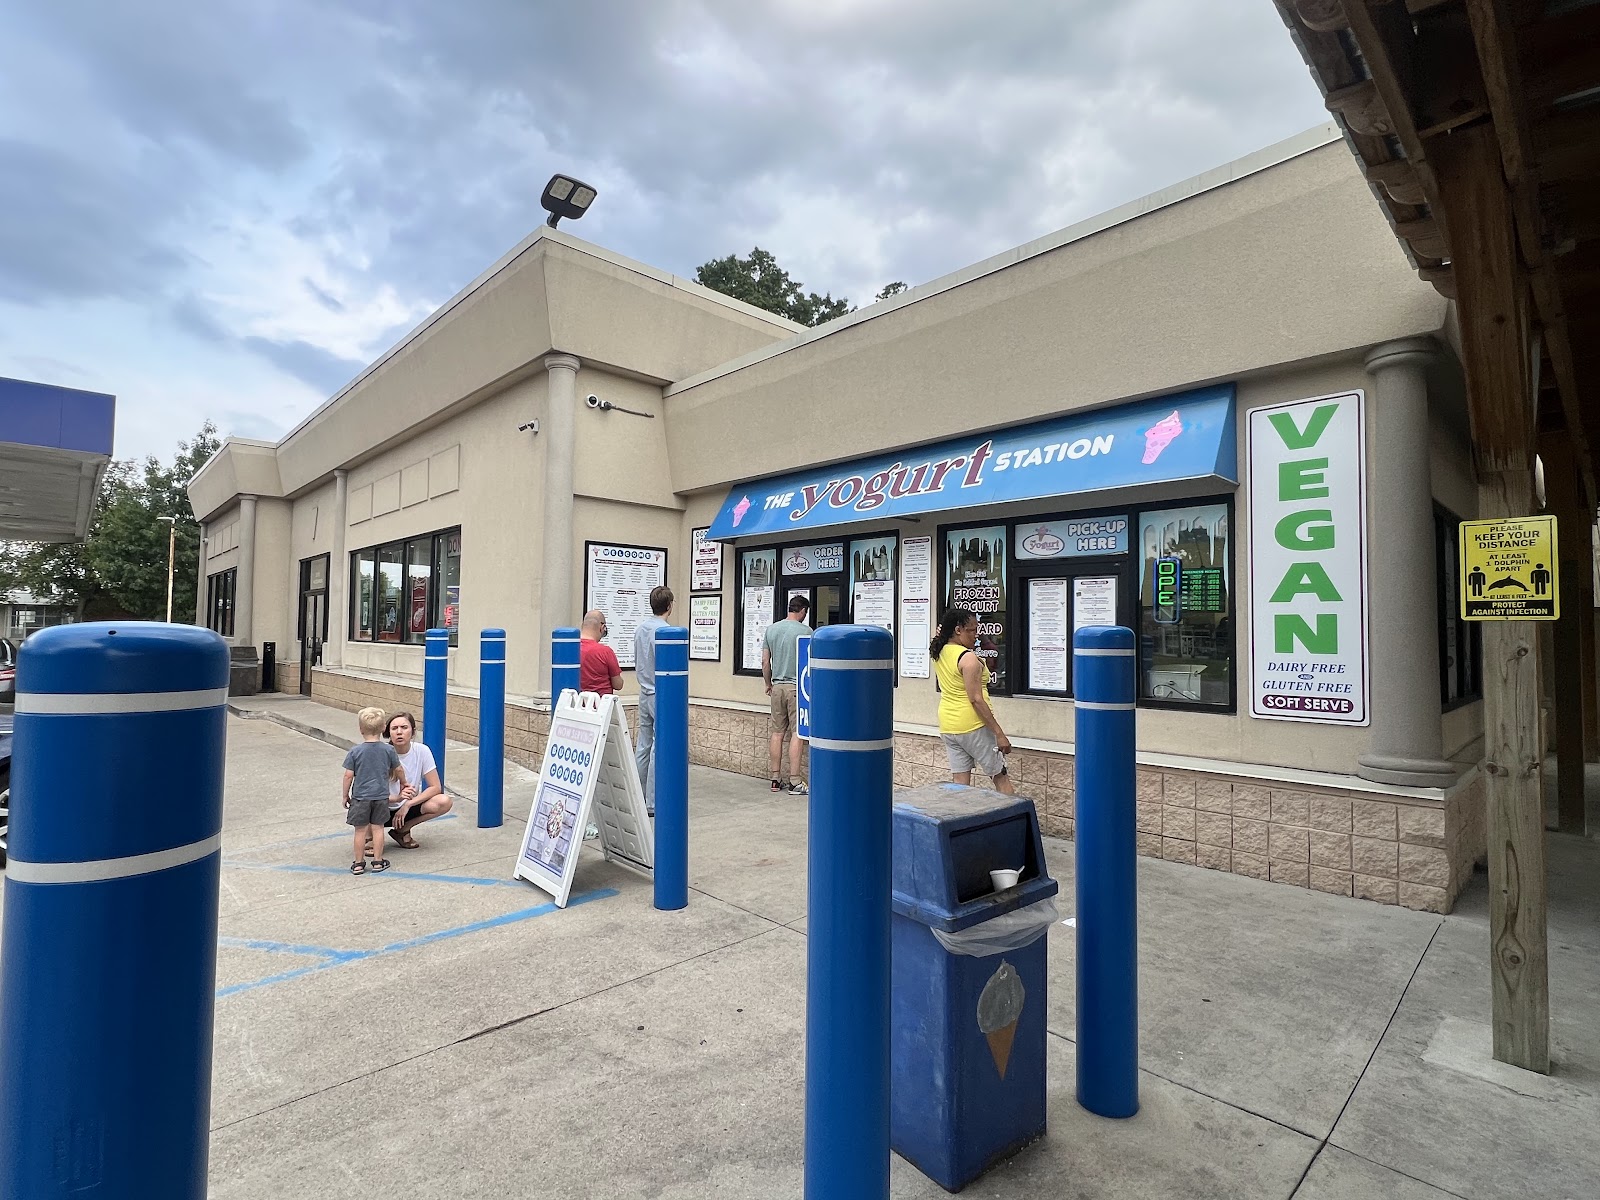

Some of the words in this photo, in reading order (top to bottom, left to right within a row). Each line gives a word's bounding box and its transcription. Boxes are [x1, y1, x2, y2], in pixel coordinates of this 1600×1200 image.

[763, 492, 795, 511] THE
[789, 440, 993, 521] yogurt
[993, 433, 1114, 472] STATION
[1068, 520, 1126, 537] PICK-UP
[1267, 403, 1343, 654] VEGAN
[1489, 525, 1524, 533] PLEASE
[1474, 533, 1505, 541] KEEP
[1508, 530, 1540, 539] YOUR
[1077, 536, 1117, 551] HERE
[1479, 539, 1536, 549] DISTANCE
[602, 548, 652, 560] WELCOME
[813, 546, 843, 558] ORDER
[817, 557, 840, 569] HERE
[953, 587, 1000, 600] FROZEN
[953, 600, 1000, 612] YOGURT
[1506, 607, 1548, 615] INFECTION
[1267, 662, 1308, 672] DAIRY
[1310, 664, 1346, 674] FREE
[1262, 680, 1314, 692] GLUTEN
[1317, 682, 1352, 693] FREE
[1266, 696, 1300, 709] SOFT
[1304, 697, 1349, 712] SERVE
[800, 707, 809, 726] PA
[551, 744, 590, 767] BUBBLE
[550, 763, 583, 786] CONES
